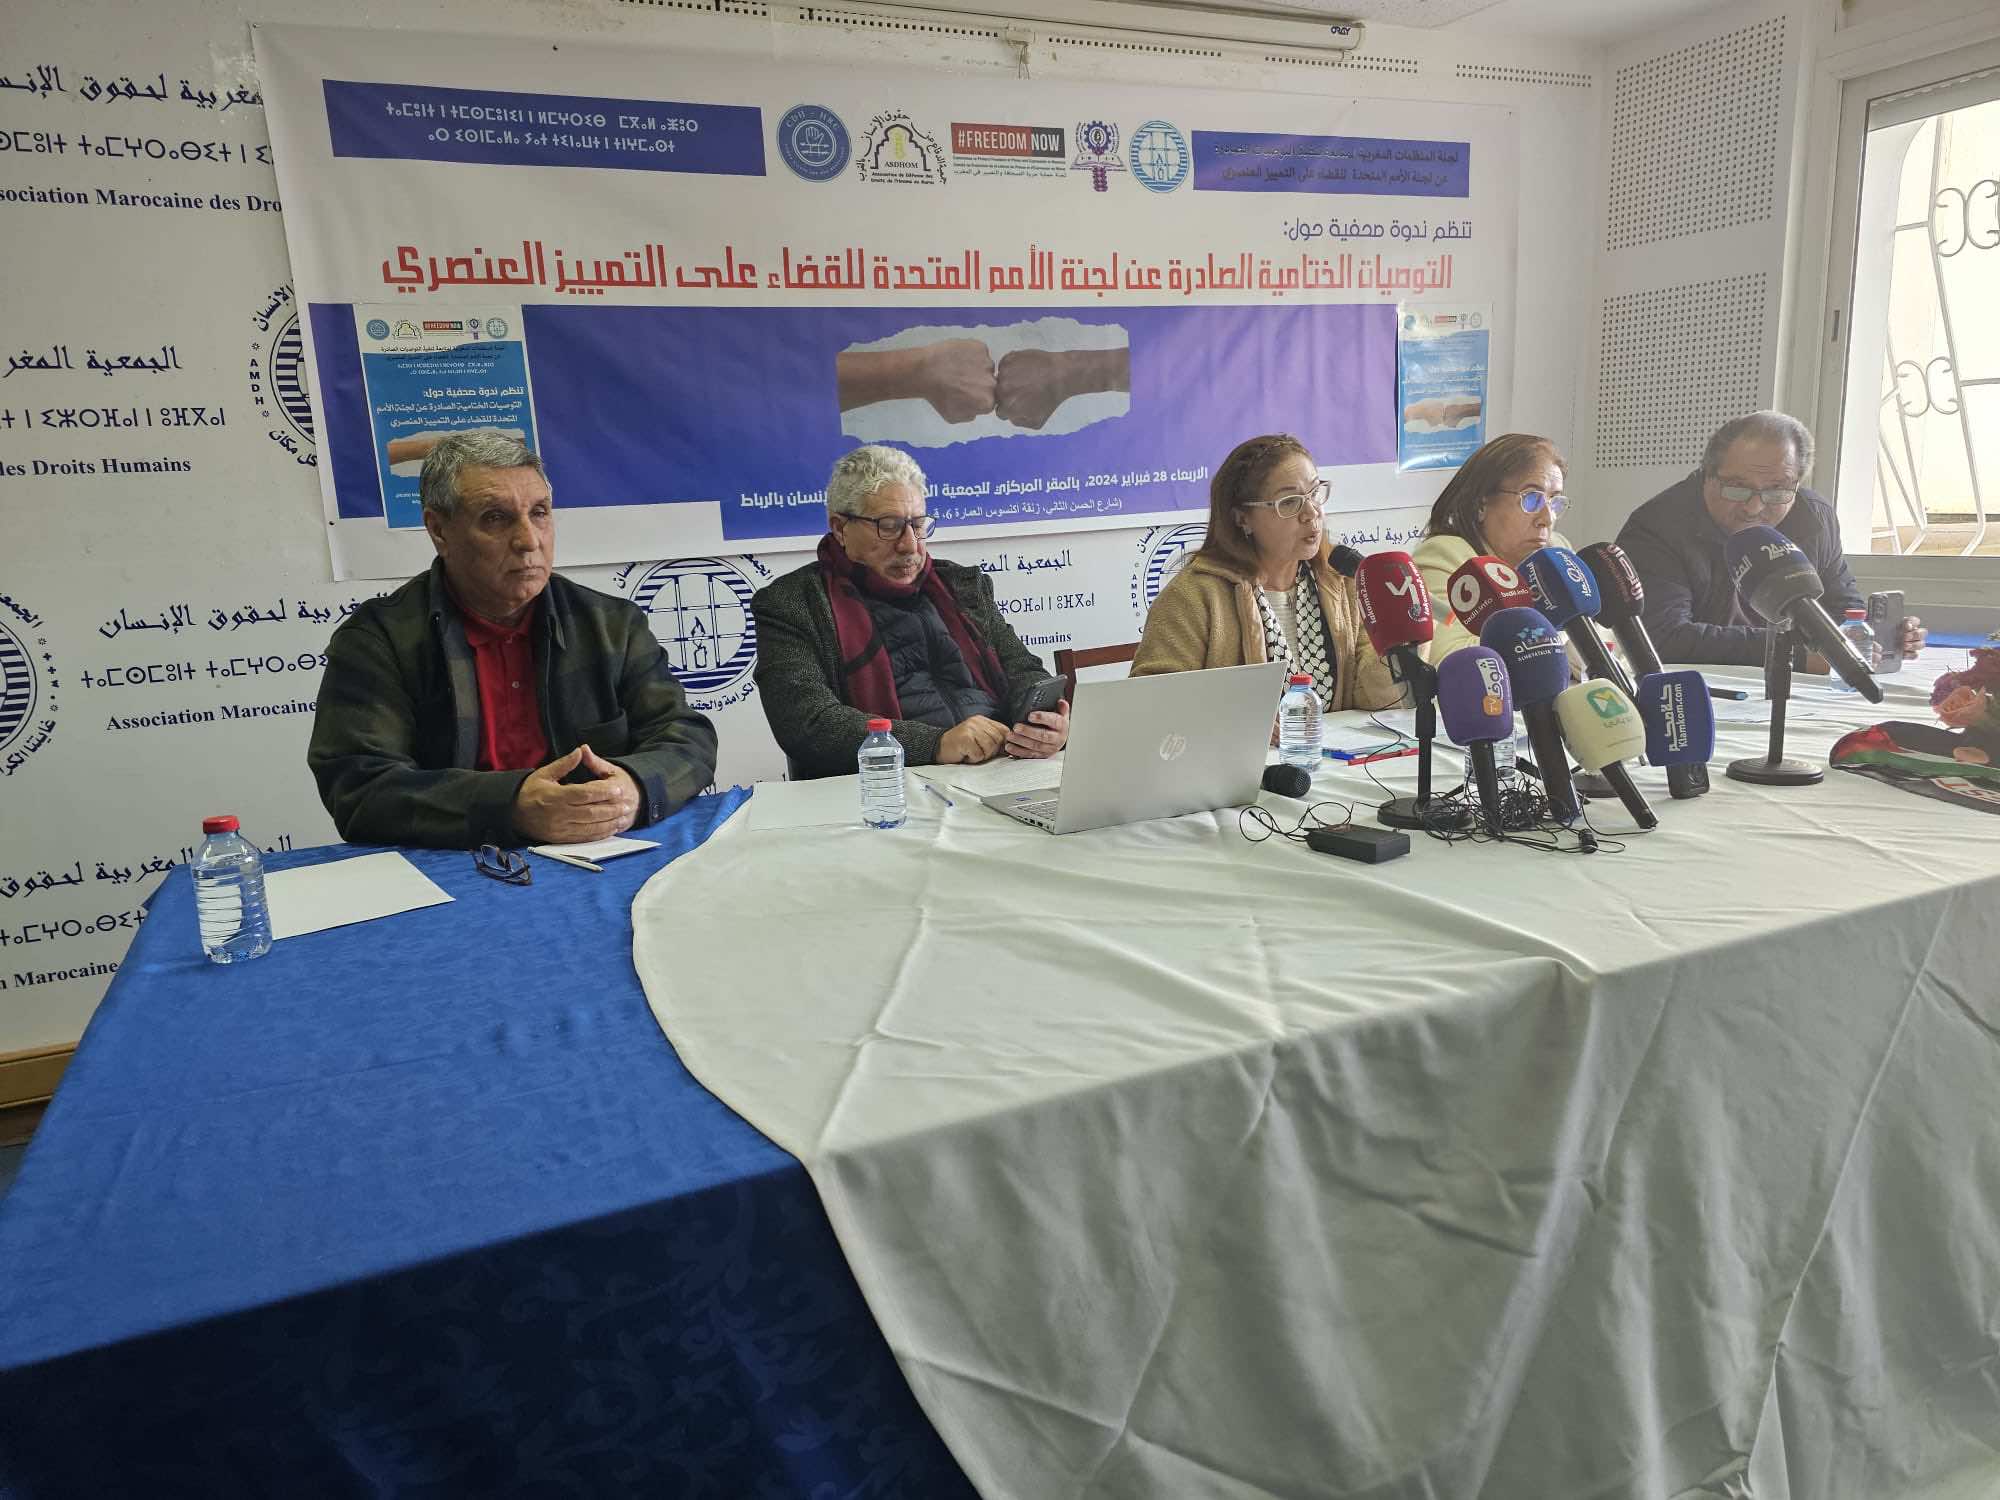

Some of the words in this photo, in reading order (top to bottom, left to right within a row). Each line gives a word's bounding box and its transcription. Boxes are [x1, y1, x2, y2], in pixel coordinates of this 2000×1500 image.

[80, 73, 168, 104] لحقوق
[958, 129, 1027, 150] #FREEDOM
[1031, 133, 1060, 151] NOW
[885, 161, 919, 169] ASDHOM
[96, 188, 204, 209] Marocaine
[209, 192, 241, 211] des
[247, 195, 282, 213] Dro
[1329, 218, 1385, 242] صحفية
[1390, 219, 1427, 242] ندوة
[1432, 220, 1472, 243] تنظم
[382, 239, 547, 294] العنصري
[553, 243, 668, 295] التمييز
[676, 246, 759, 289] على
[767, 247, 866, 290] للقضاء
[873, 249, 981, 291] المتحدة
[989, 242, 1054, 293] الأمم
[1061, 251, 1118, 298] لجنة
[1125, 259, 1162, 290] عن
[1168, 252, 1253, 296] الصادرة
[1258, 253, 1352, 297] الختامية
[1357, 253, 1453, 296] التوصيات
[3, 345, 76, 378] المغر
[87, 345, 183, 377] الجمعية
[249, 358, 264, 405] AMDH
[33, 459, 96, 476] Droits
[100, 457, 192, 474] Humains
[1120, 472, 1151, 488] فبراير
[1152, 470, 1168, 482] 28
[740, 493, 784, 509] بالرباط
[941, 481, 990, 498] للجمعية
[993, 478, 1043, 497] المركزي
[1045, 477, 1080, 495] بالمقر
[979, 554, 1009, 573] المغ
[1017, 550, 1073, 575] الجمعية
[98, 603, 197, 639] الإنسان
[207, 598, 288, 632] لحقوق
[1020, 632, 1072, 647] Humains
[105, 708, 215, 731] Association
[221, 699, 318, 721] Marocaine
[1675, 683, 1689, 747] Klamkom.com
[1159, 733, 1186, 760] hp
[14, 961, 119, 989] Marocaine
